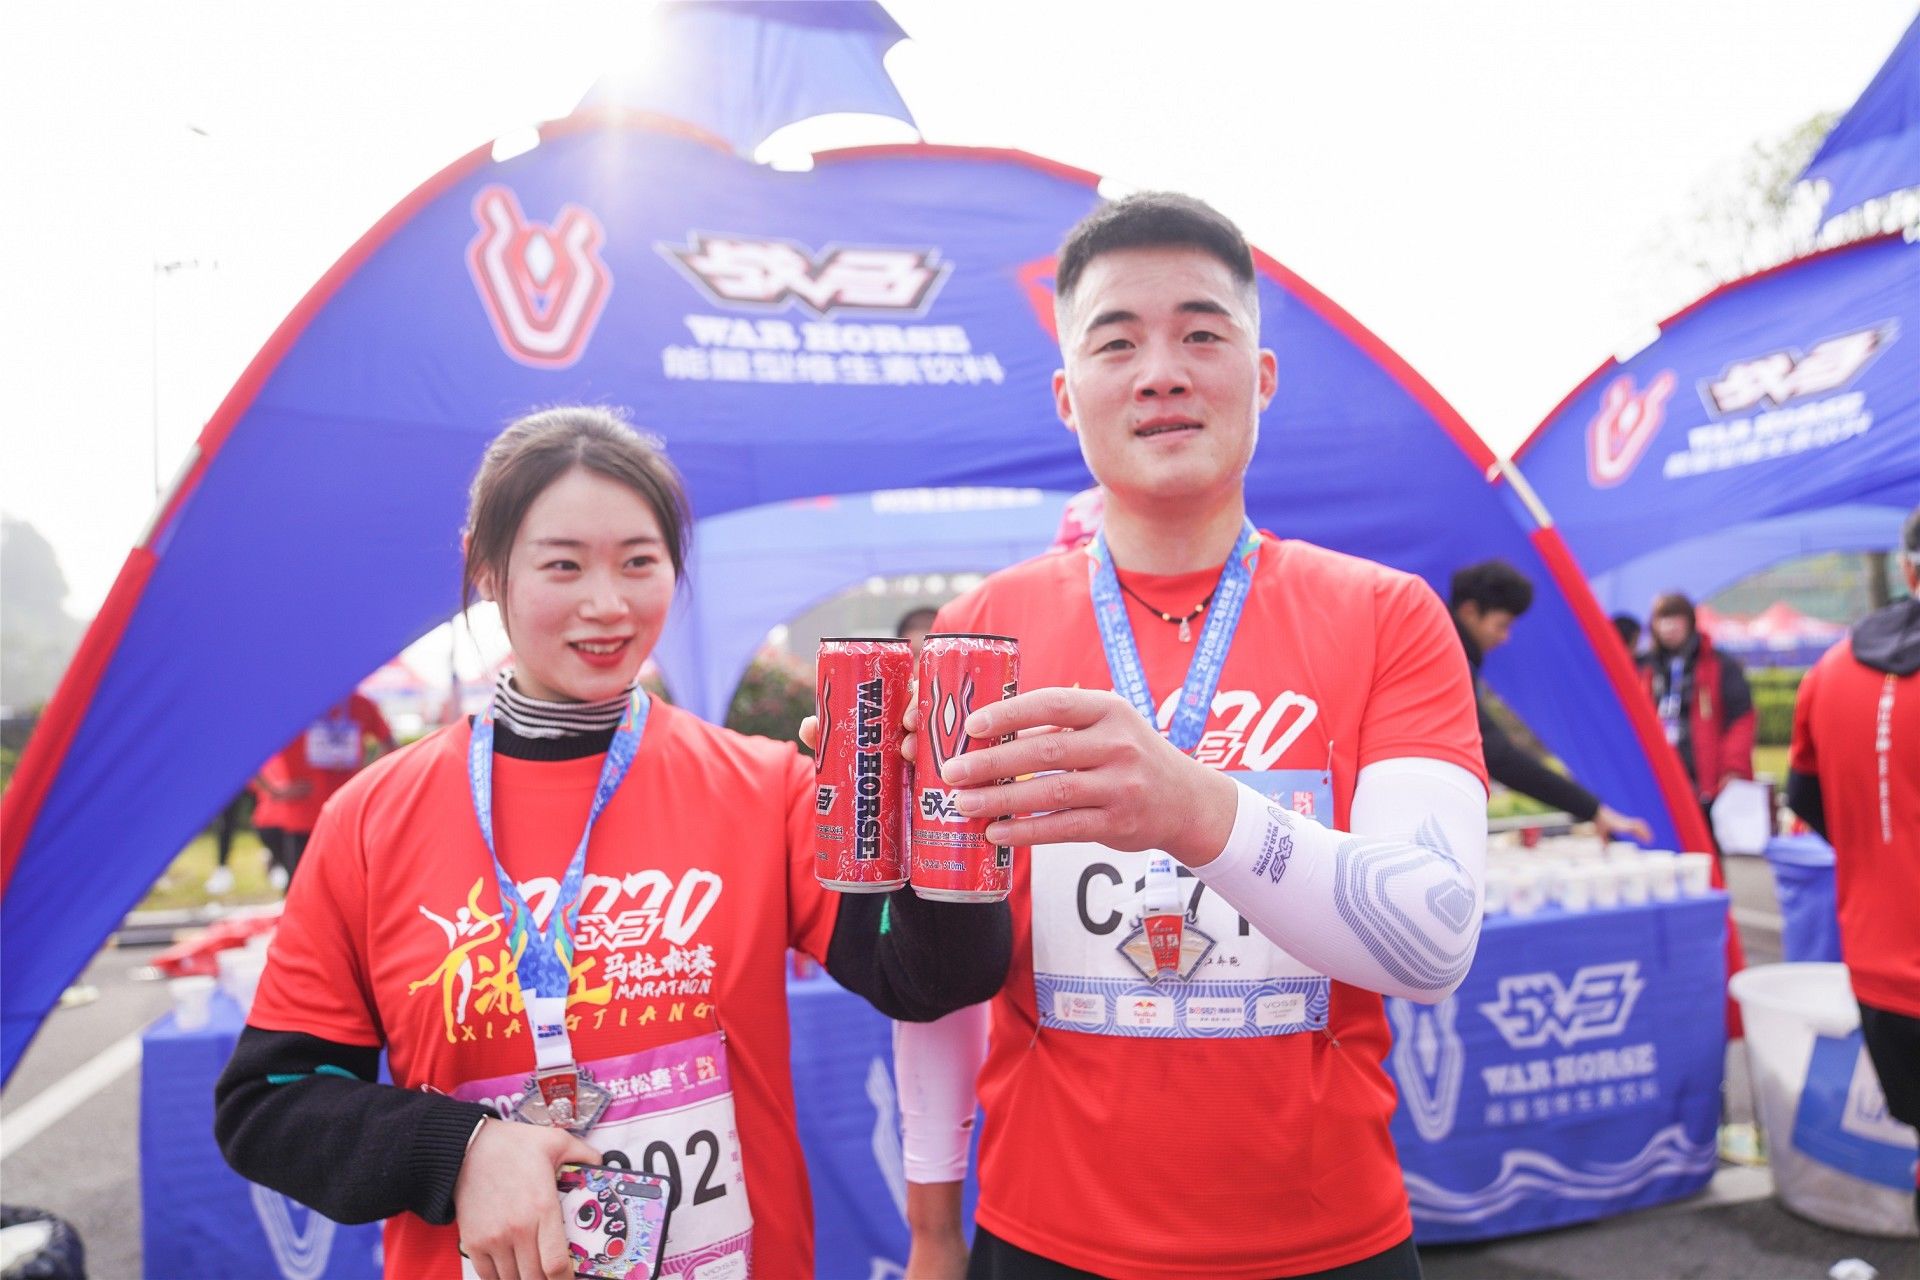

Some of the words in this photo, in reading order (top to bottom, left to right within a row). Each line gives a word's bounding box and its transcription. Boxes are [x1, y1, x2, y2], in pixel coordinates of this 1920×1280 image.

[686, 317, 800, 350] WAR
[806, 321, 969, 353] HORSE
[856, 678, 883, 748] WAR
[855, 752, 882, 861] HORSE
[1256, 845, 1275, 876] HORSE
[602, 945, 717, 984] 马拉松赛
[613, 979, 713, 1001] MARATHON
[1482, 1057, 1551, 1095] WAR
[1555, 1044, 1656, 1085] HORSE
